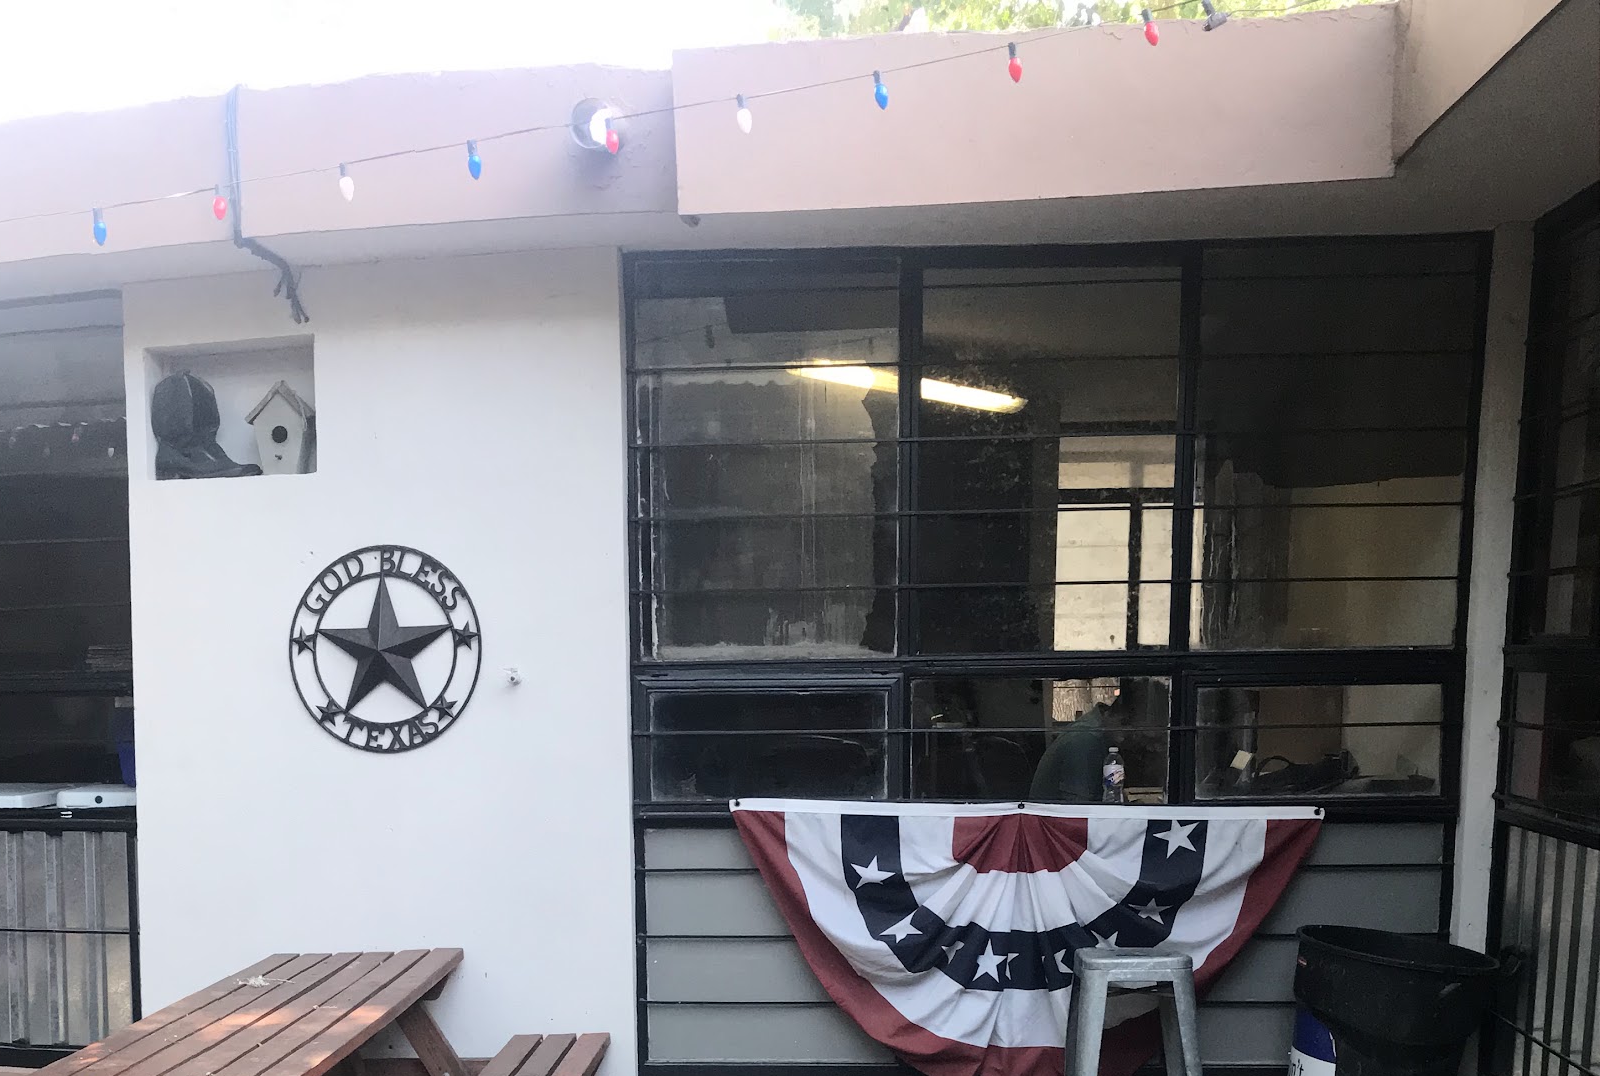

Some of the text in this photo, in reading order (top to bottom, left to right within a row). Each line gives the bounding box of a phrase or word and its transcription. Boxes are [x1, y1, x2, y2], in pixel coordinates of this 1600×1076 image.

[303, 549, 466, 614] GOD BLESS
[342, 713, 439, 750] TEXAS
